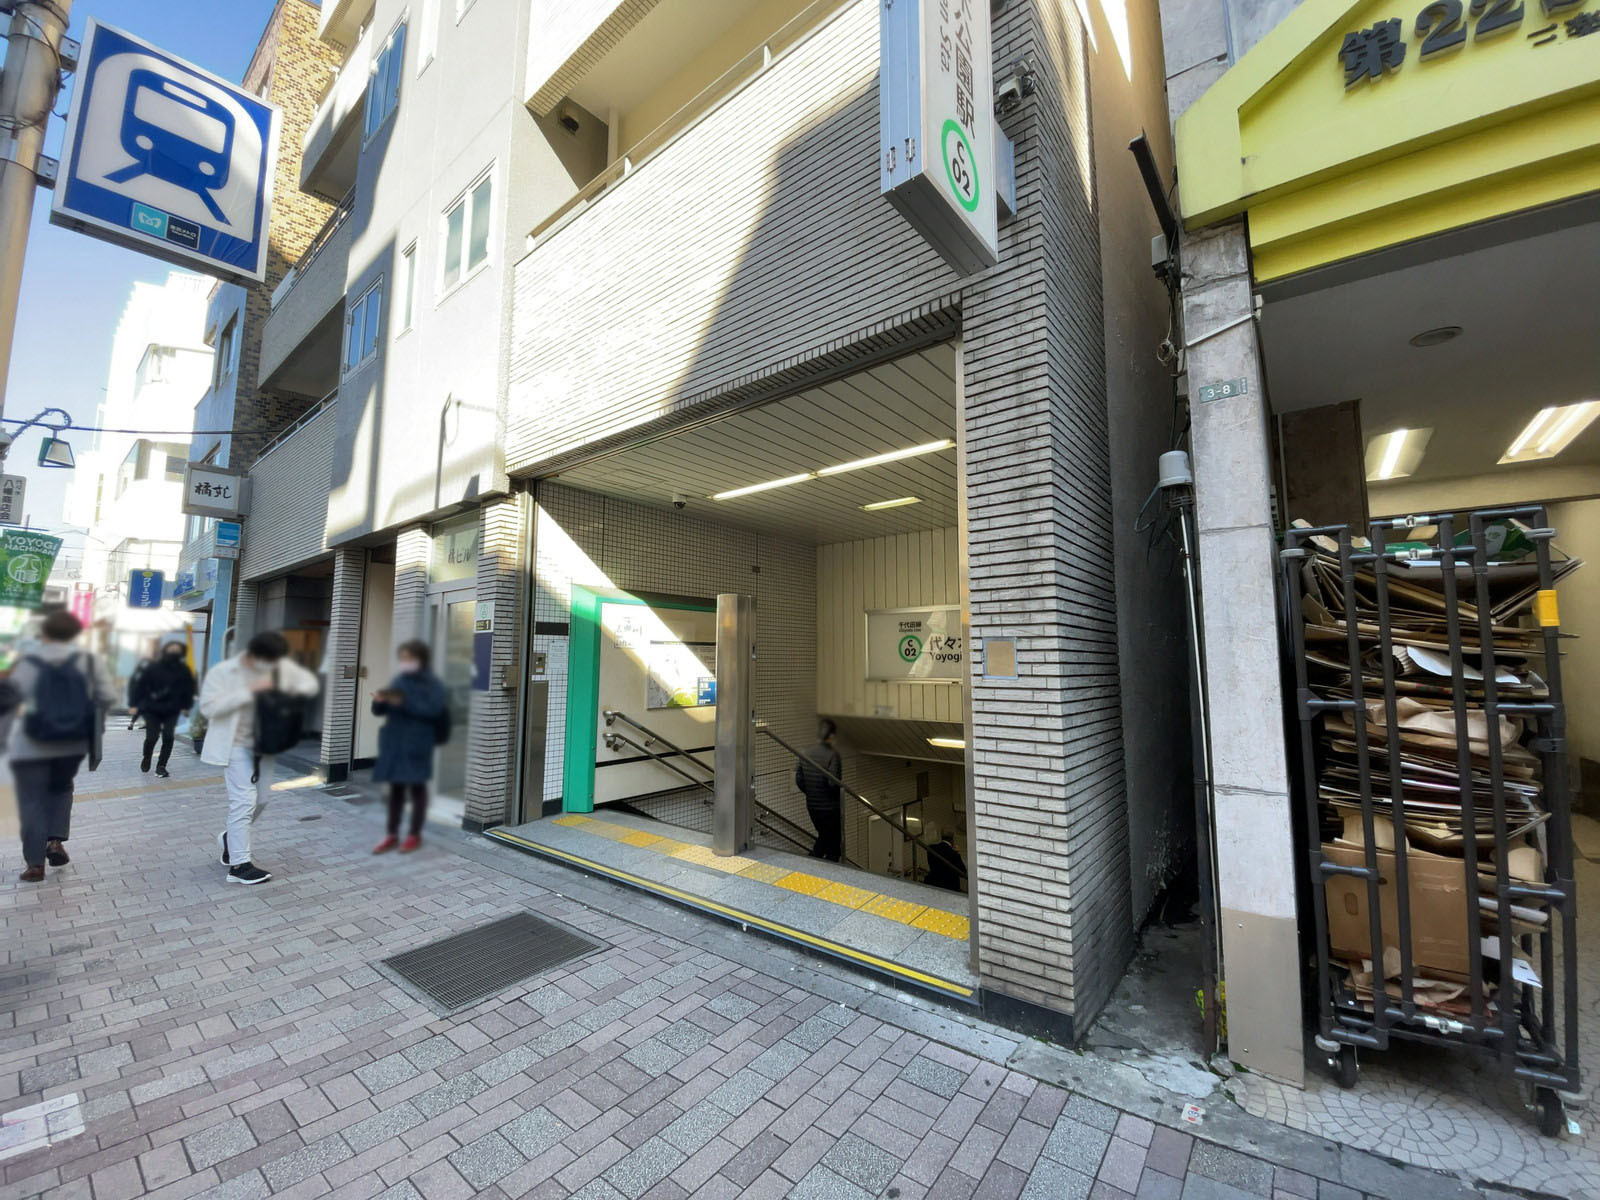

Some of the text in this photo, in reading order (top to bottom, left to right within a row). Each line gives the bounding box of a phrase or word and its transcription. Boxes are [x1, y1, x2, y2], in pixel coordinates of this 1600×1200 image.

[940, 25, 952, 72] Sta.
[957, 140, 965, 165] C
[952, 157, 970, 197] 02
[1208, 384, 1230, 398] 3-8
[4, 543, 56, 556] HACHIMAN
[6, 534, 58, 551] YOYOGI
[907, 639, 913, 647] C
[904, 647, 917, 656] 02
